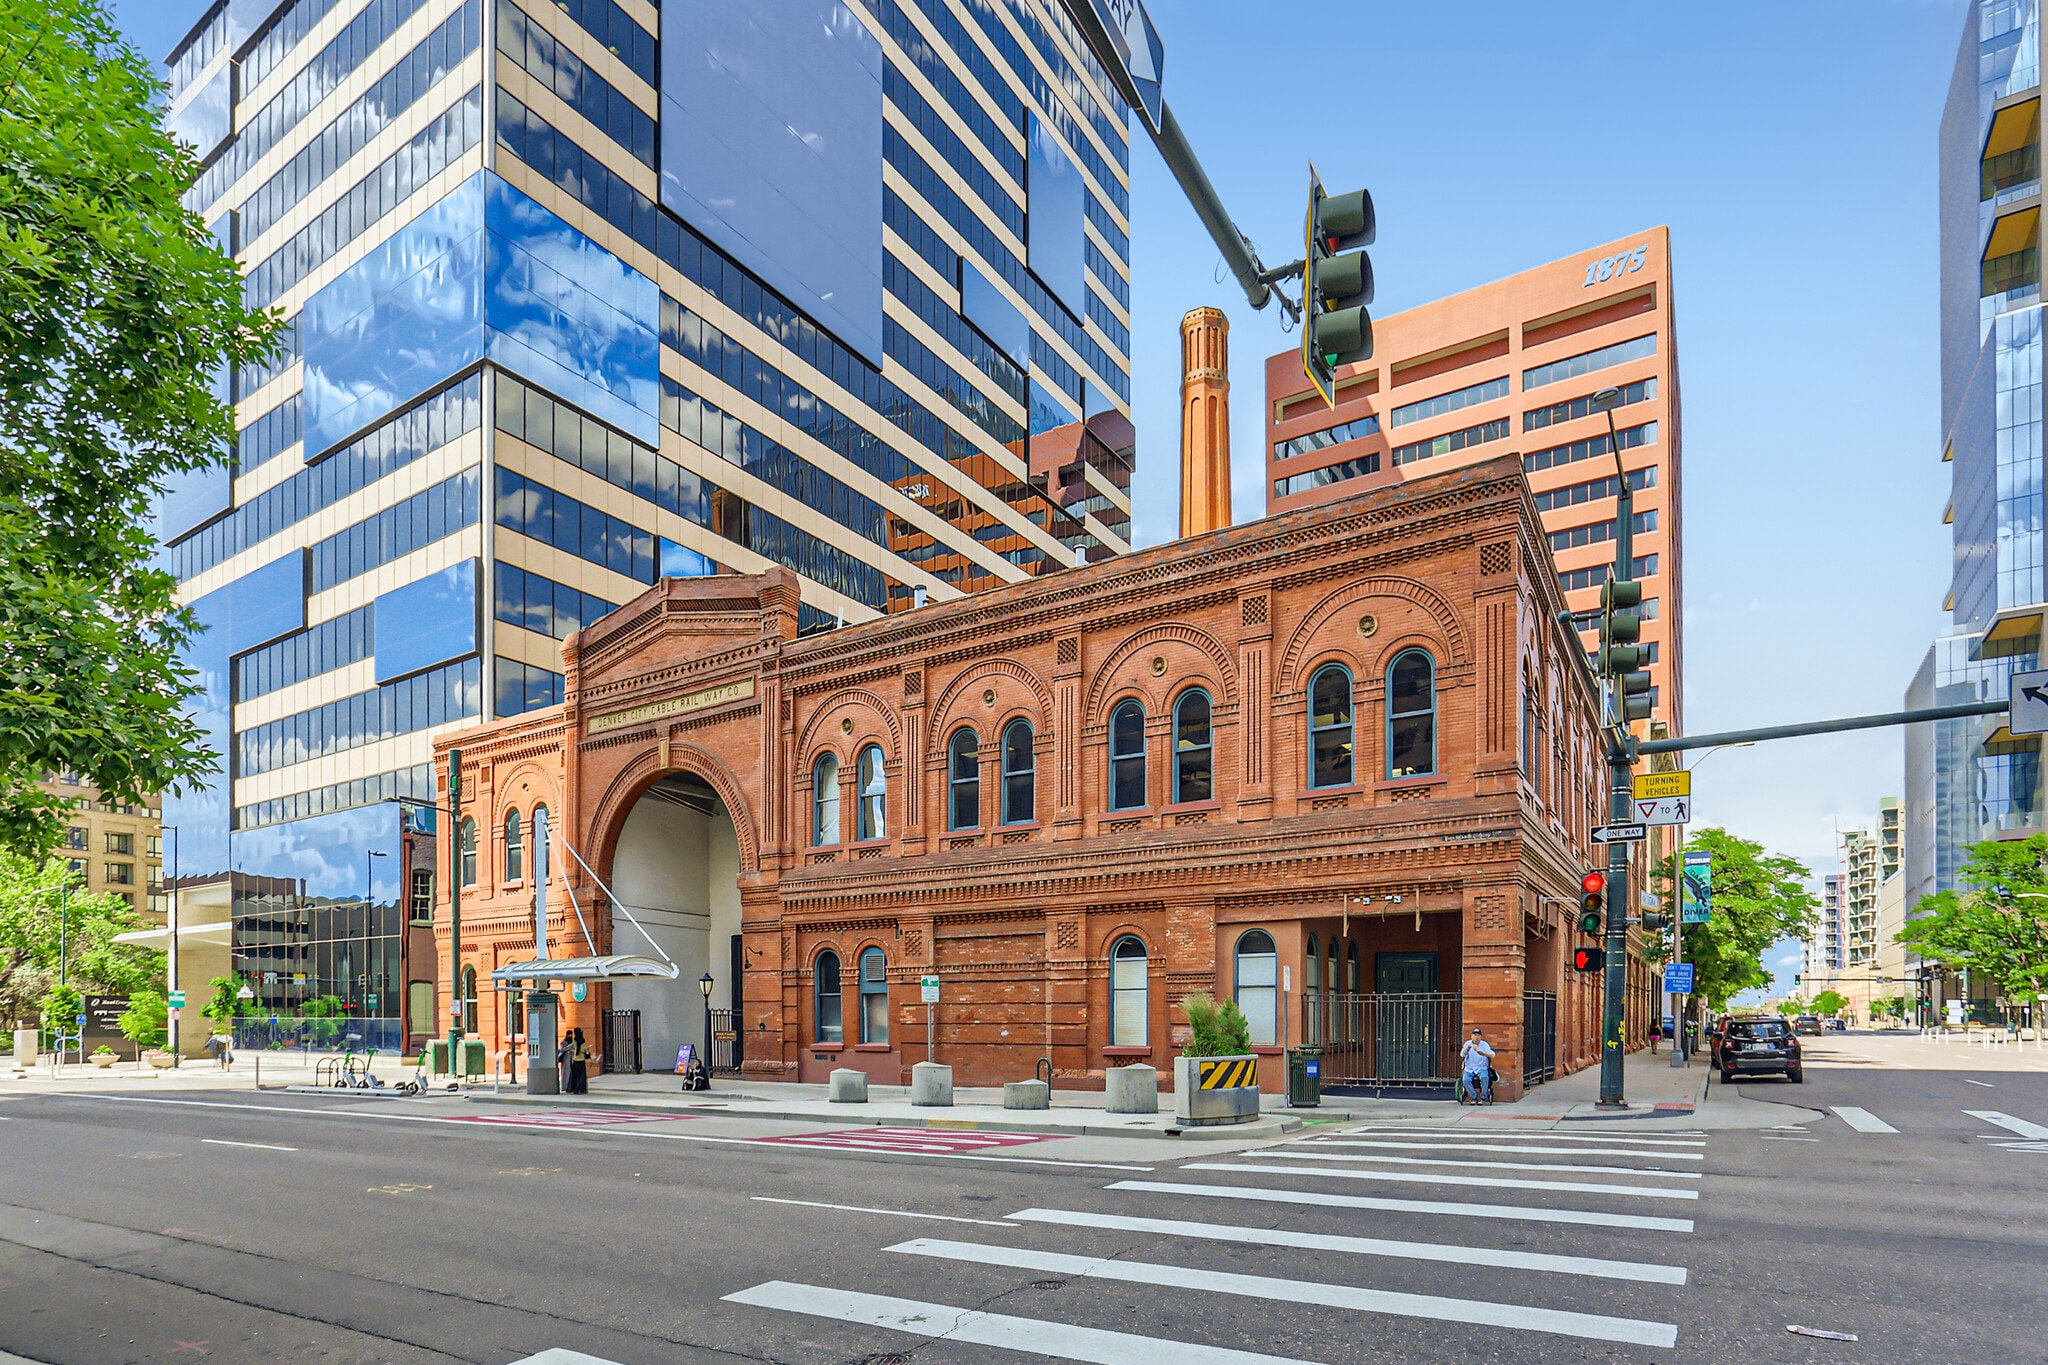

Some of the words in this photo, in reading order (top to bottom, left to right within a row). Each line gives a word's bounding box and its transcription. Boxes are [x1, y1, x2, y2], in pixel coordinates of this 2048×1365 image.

[1107, 0, 1132, 36] AY
[1582, 244, 1649, 288] 1875
[598, 712, 627, 728] DENVER
[630, 707, 648, 720] CITY
[651, 701, 676, 716] CABLE
[680, 696, 699, 710] RAIL
[704, 689, 723, 702] WAY
[727, 685, 739, 697] CO
[1645, 776, 1680, 786] TURNING
[1645, 786, 1680, 796] VEHICLES
[1606, 830, 1622, 838] ONE
[1624, 828, 1641, 836] WAY
[1684, 908, 1709, 916] DIVER
